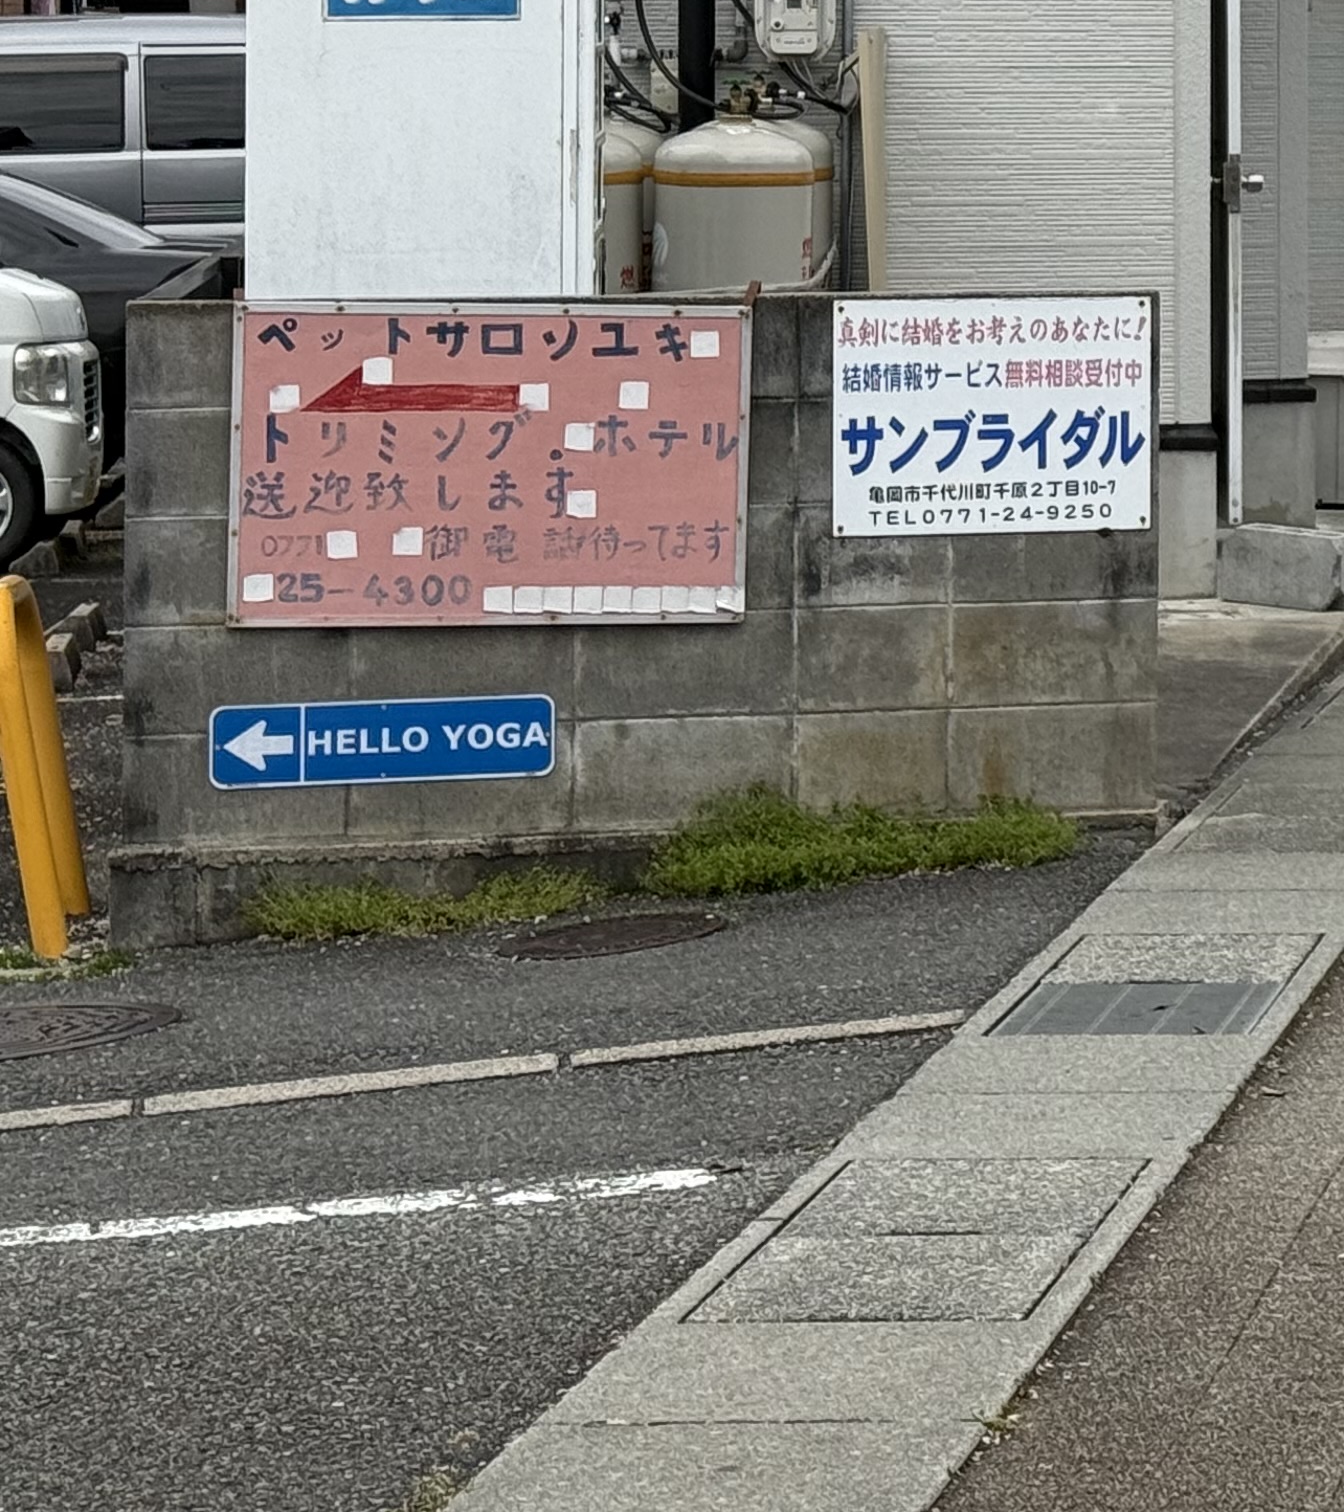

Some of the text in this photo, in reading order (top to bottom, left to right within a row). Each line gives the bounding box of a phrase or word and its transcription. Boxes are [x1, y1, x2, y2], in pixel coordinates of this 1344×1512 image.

[841, 405, 1147, 476] サンブライダル
[306, 720, 549, 757] HELLO YOGA
